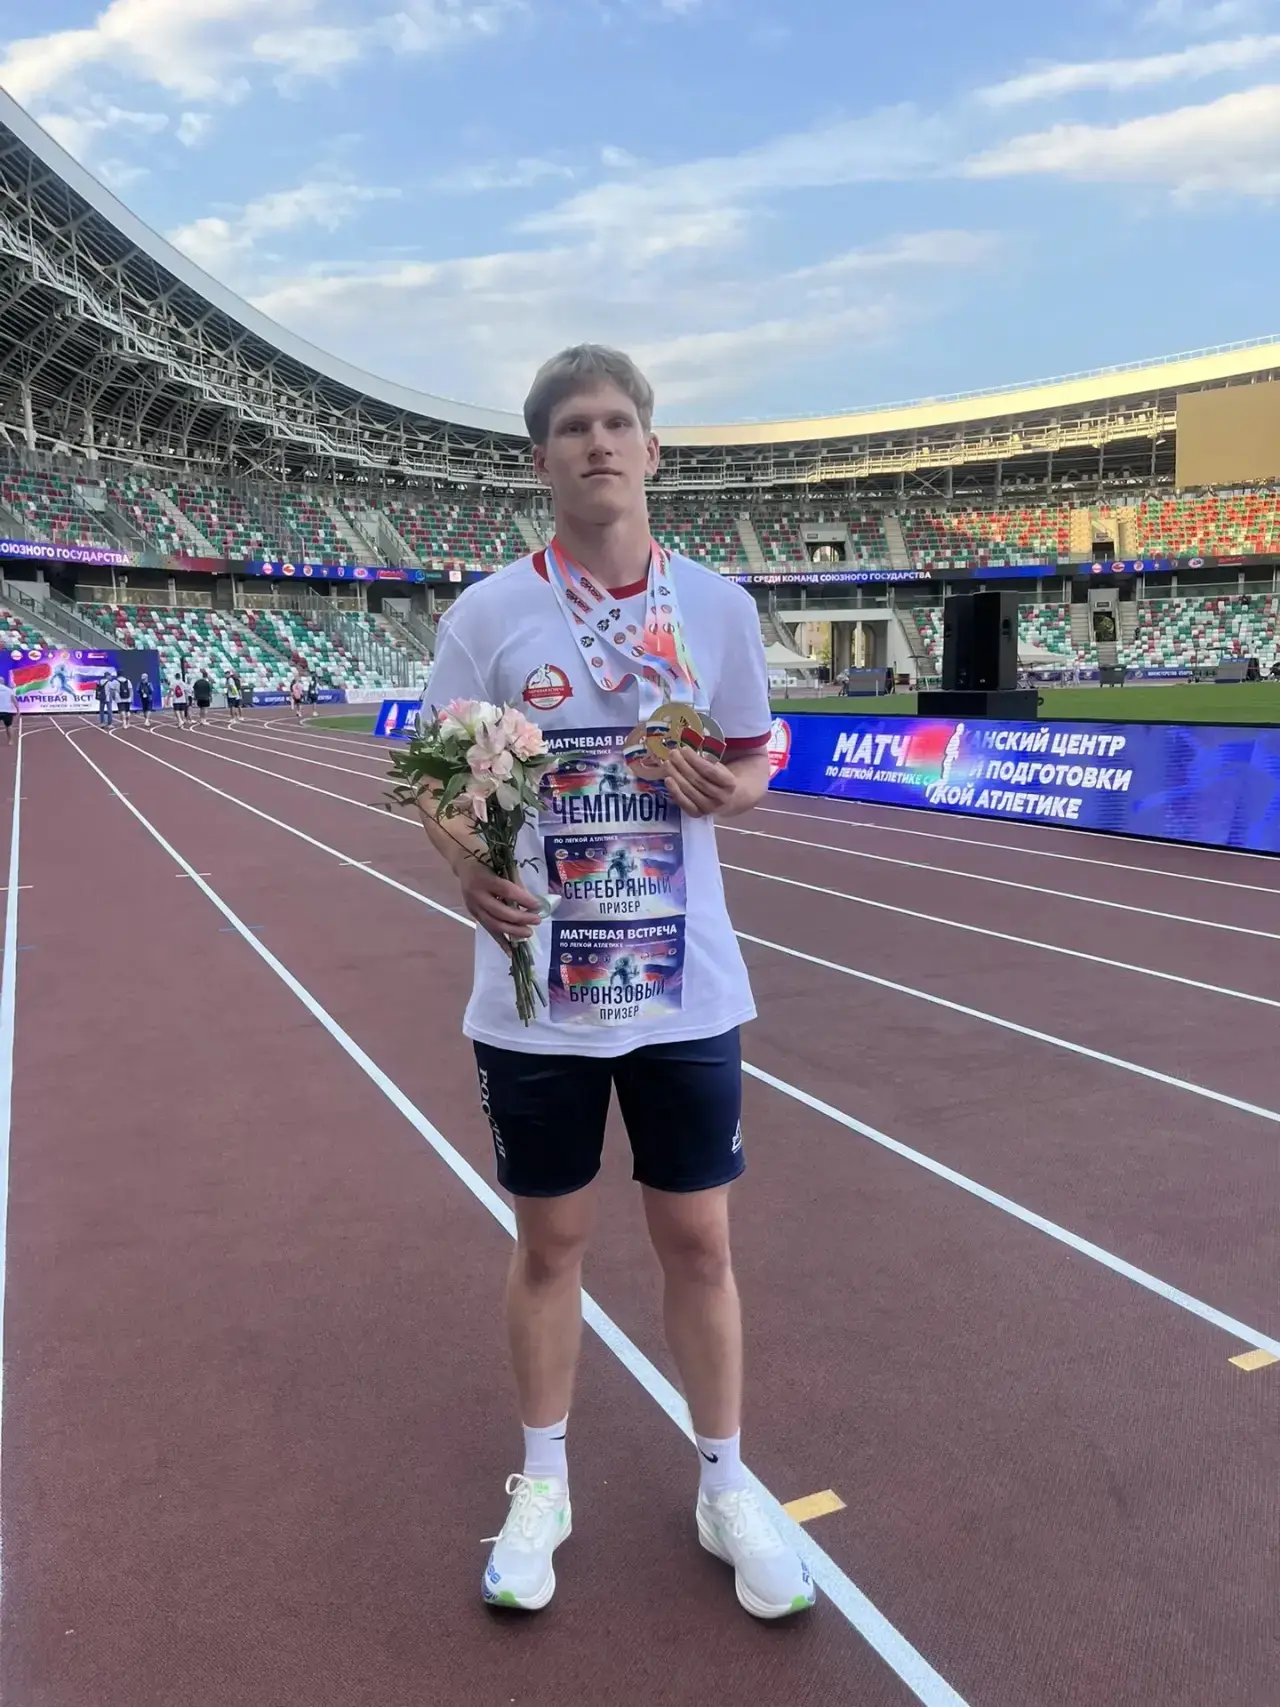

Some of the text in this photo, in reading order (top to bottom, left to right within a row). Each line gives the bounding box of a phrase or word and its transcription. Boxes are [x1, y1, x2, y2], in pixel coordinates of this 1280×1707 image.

[57, 549, 129, 563] ГОСУДАРСТВА
[754, 575, 780, 583] СРЕДИ
[782, 574, 818, 583] КОМАНД
[820, 572, 868, 581] СОЮЗНОГО
[870, 571, 931, 580] ГОСУДАРСТВА
[545, 736, 612, 749] МАТЧЕВАЯ
[1052, 733, 1126, 757] ЦЕНТР
[825, 766, 838, 777] ПО
[839, 767, 874, 780] ЛЕГКОЙ
[873, 770, 921, 785] АТЛЕТИКЕ
[986, 760, 1133, 791] ПОДГОТОВКИ
[552, 793, 667, 824] ЧЕМПИОН
[975, 788, 1082, 819] АТЛЕТИКЕ
[564, 875, 672, 899] СЕРЕБРЯНЫЙ
[600, 901, 640, 914] ПРИЗЕР
[560, 924, 677, 940] МАТЧЕВАЯ ВСТРЕЧА
[569, 979, 665, 1005] БРОНЗОВЫЙ
[600, 1006, 639, 1020] ПРИЗЕР
